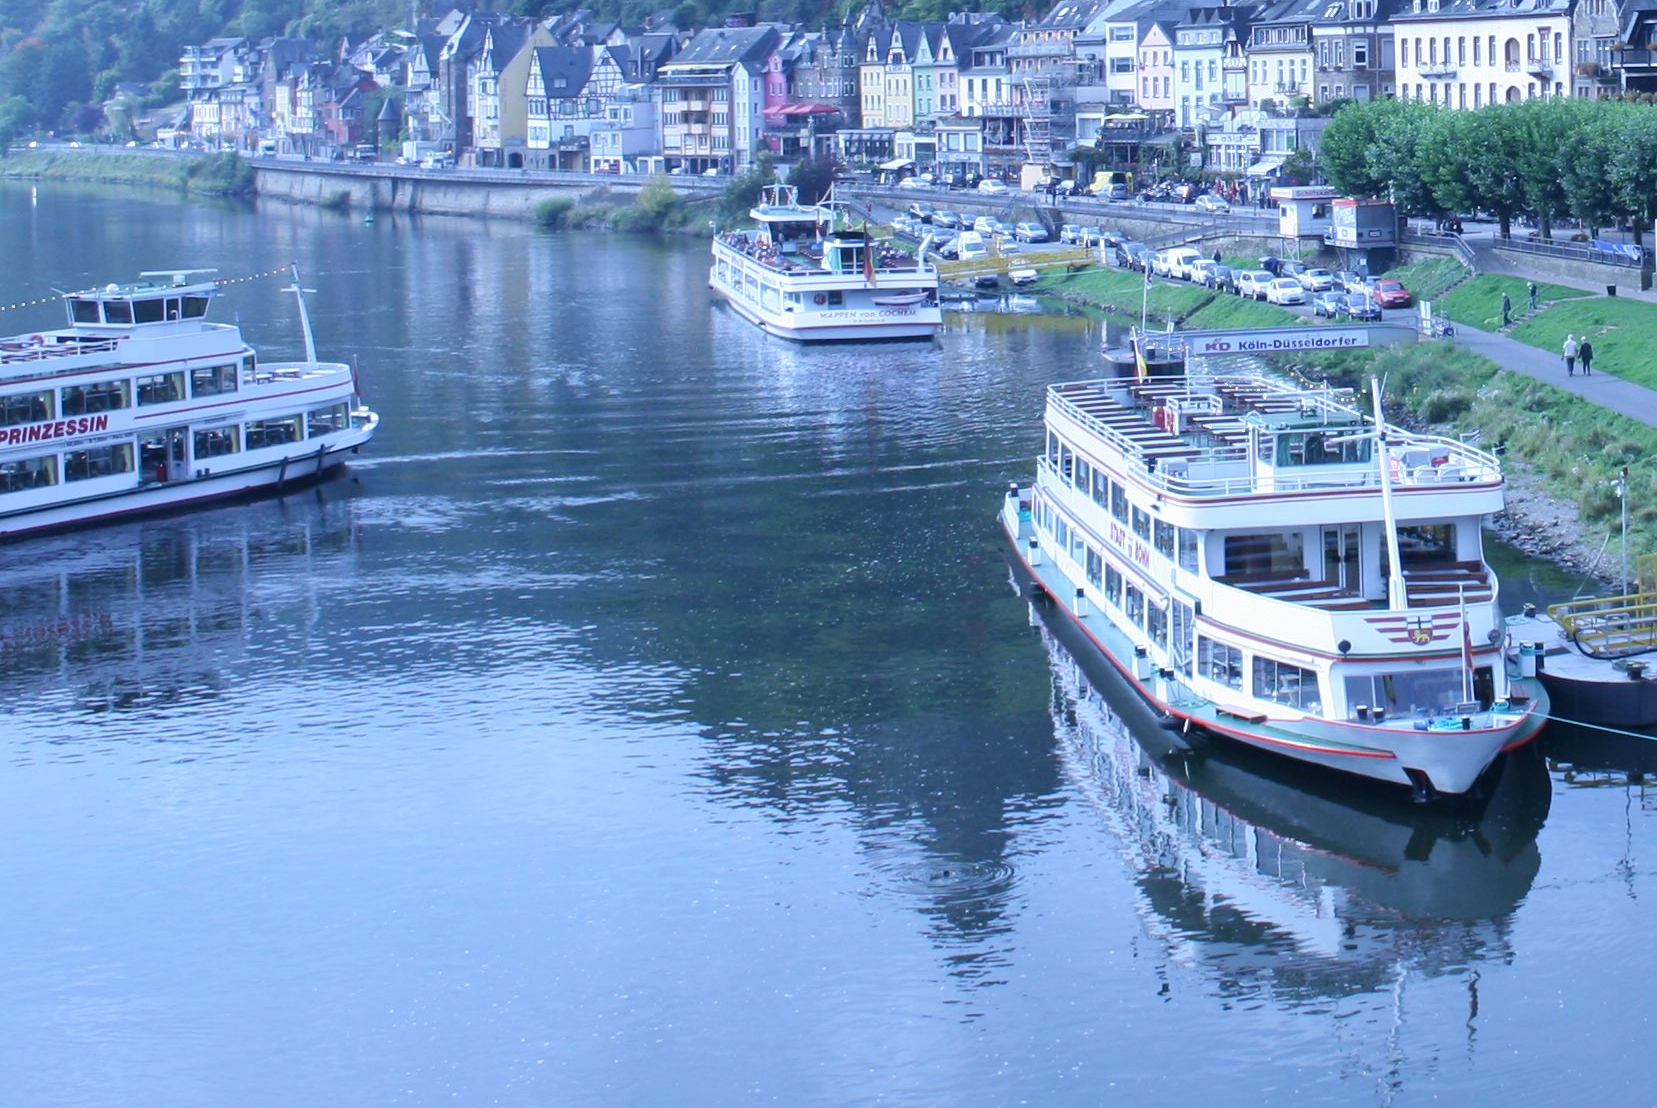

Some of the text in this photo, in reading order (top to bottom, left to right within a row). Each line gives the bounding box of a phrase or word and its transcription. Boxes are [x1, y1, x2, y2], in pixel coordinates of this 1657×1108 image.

[878, 309, 917, 317] COCHEM
[1205, 336, 1358, 352] KD Köln-Düsseldorfer
[0, 414, 109, 446] PRINZESSIN
